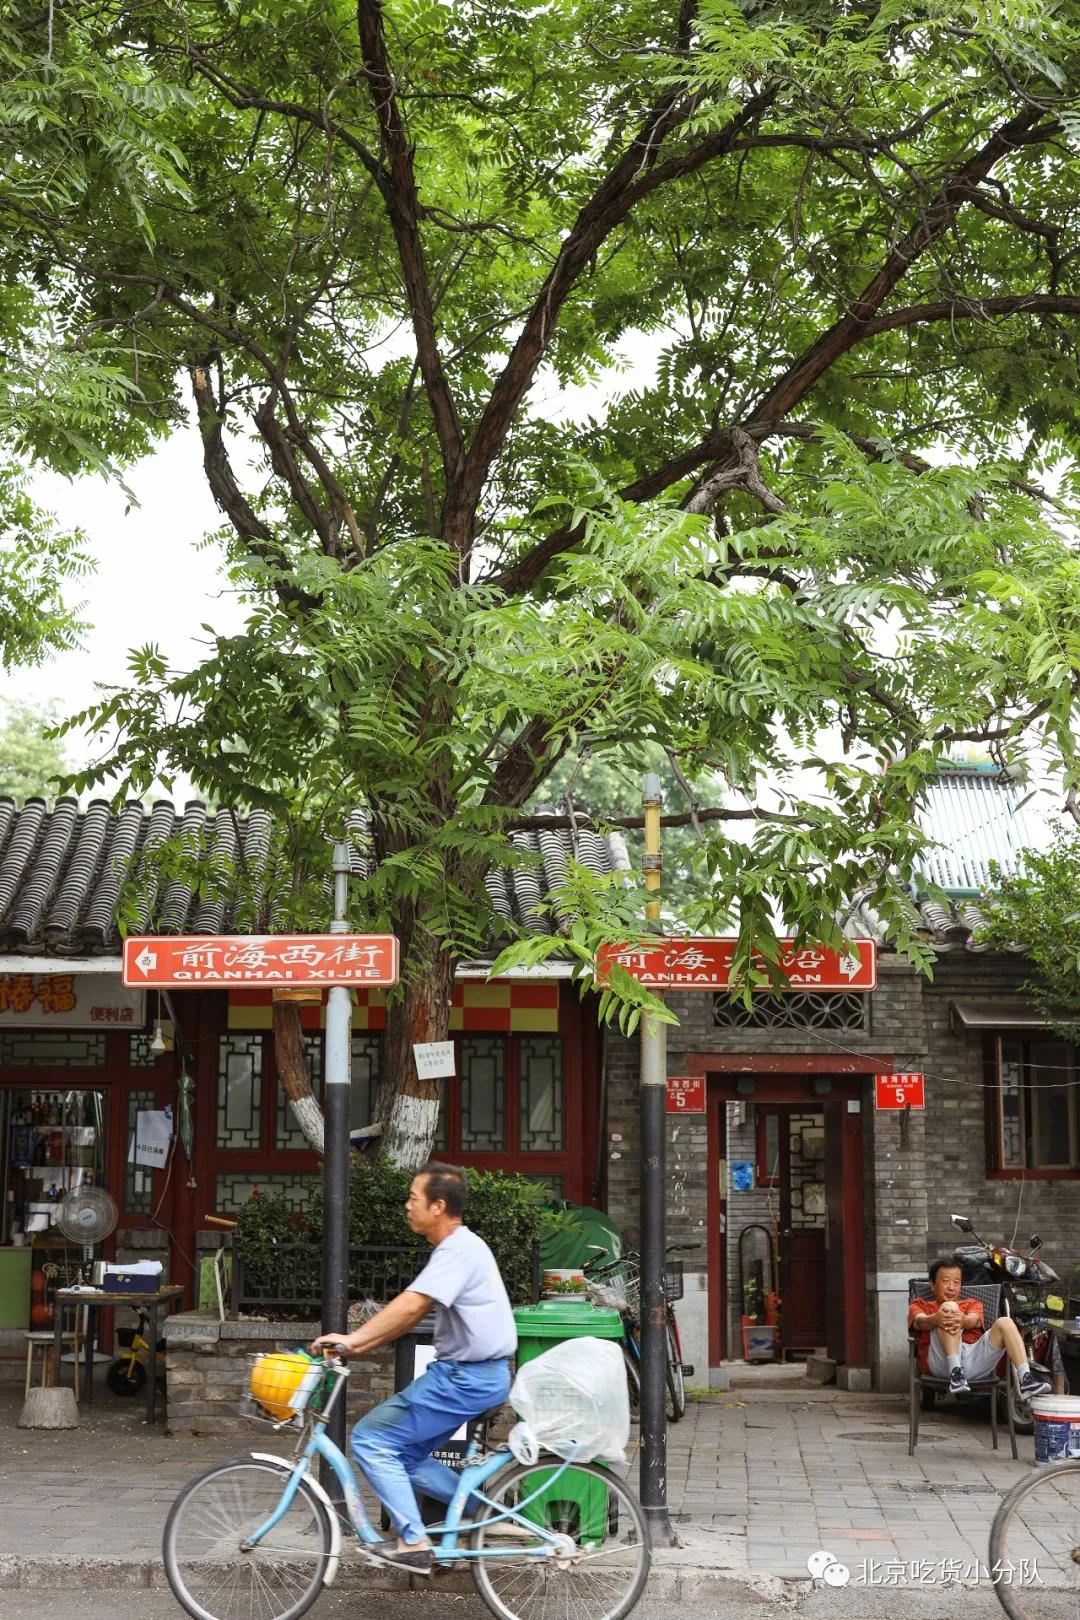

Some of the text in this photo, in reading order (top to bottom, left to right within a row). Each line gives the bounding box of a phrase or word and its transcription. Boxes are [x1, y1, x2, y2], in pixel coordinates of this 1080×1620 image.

[172, 943, 385, 969] 前海西街
[844, 960, 855, 972] 东
[173, 969, 382, 980] QIANHAI XIJIE
[632, 972, 718, 982] IANHAI
[90, 1006, 135, 1022] 便利店
[895, 1088, 905, 1104] 5
